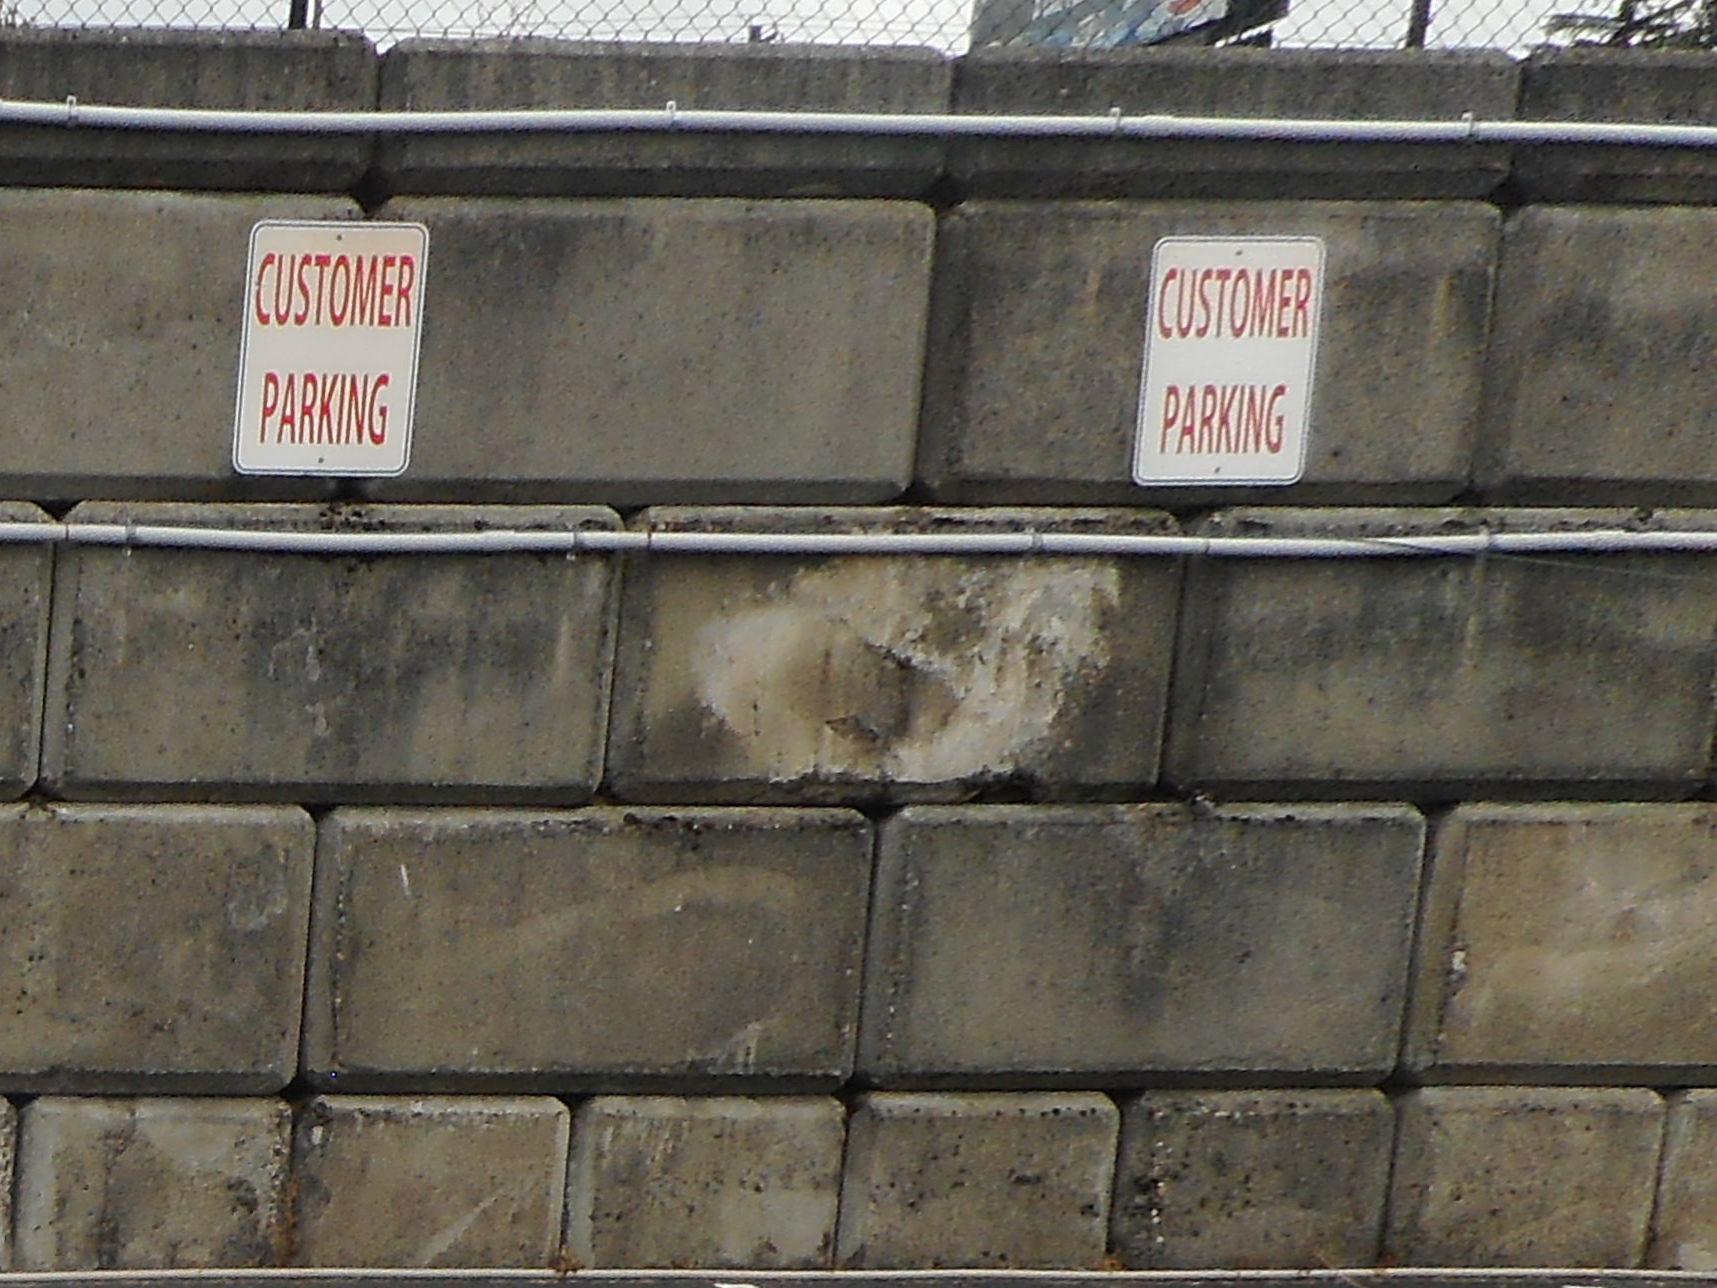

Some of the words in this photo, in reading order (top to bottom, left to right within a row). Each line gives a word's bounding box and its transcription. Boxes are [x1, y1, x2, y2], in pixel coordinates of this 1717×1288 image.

[256, 253, 417, 327] CUSTOMER
[1157, 269, 1312, 339] CUSTOMER
[261, 373, 391, 444] PARKING
[1159, 385, 1287, 455] PARKING
